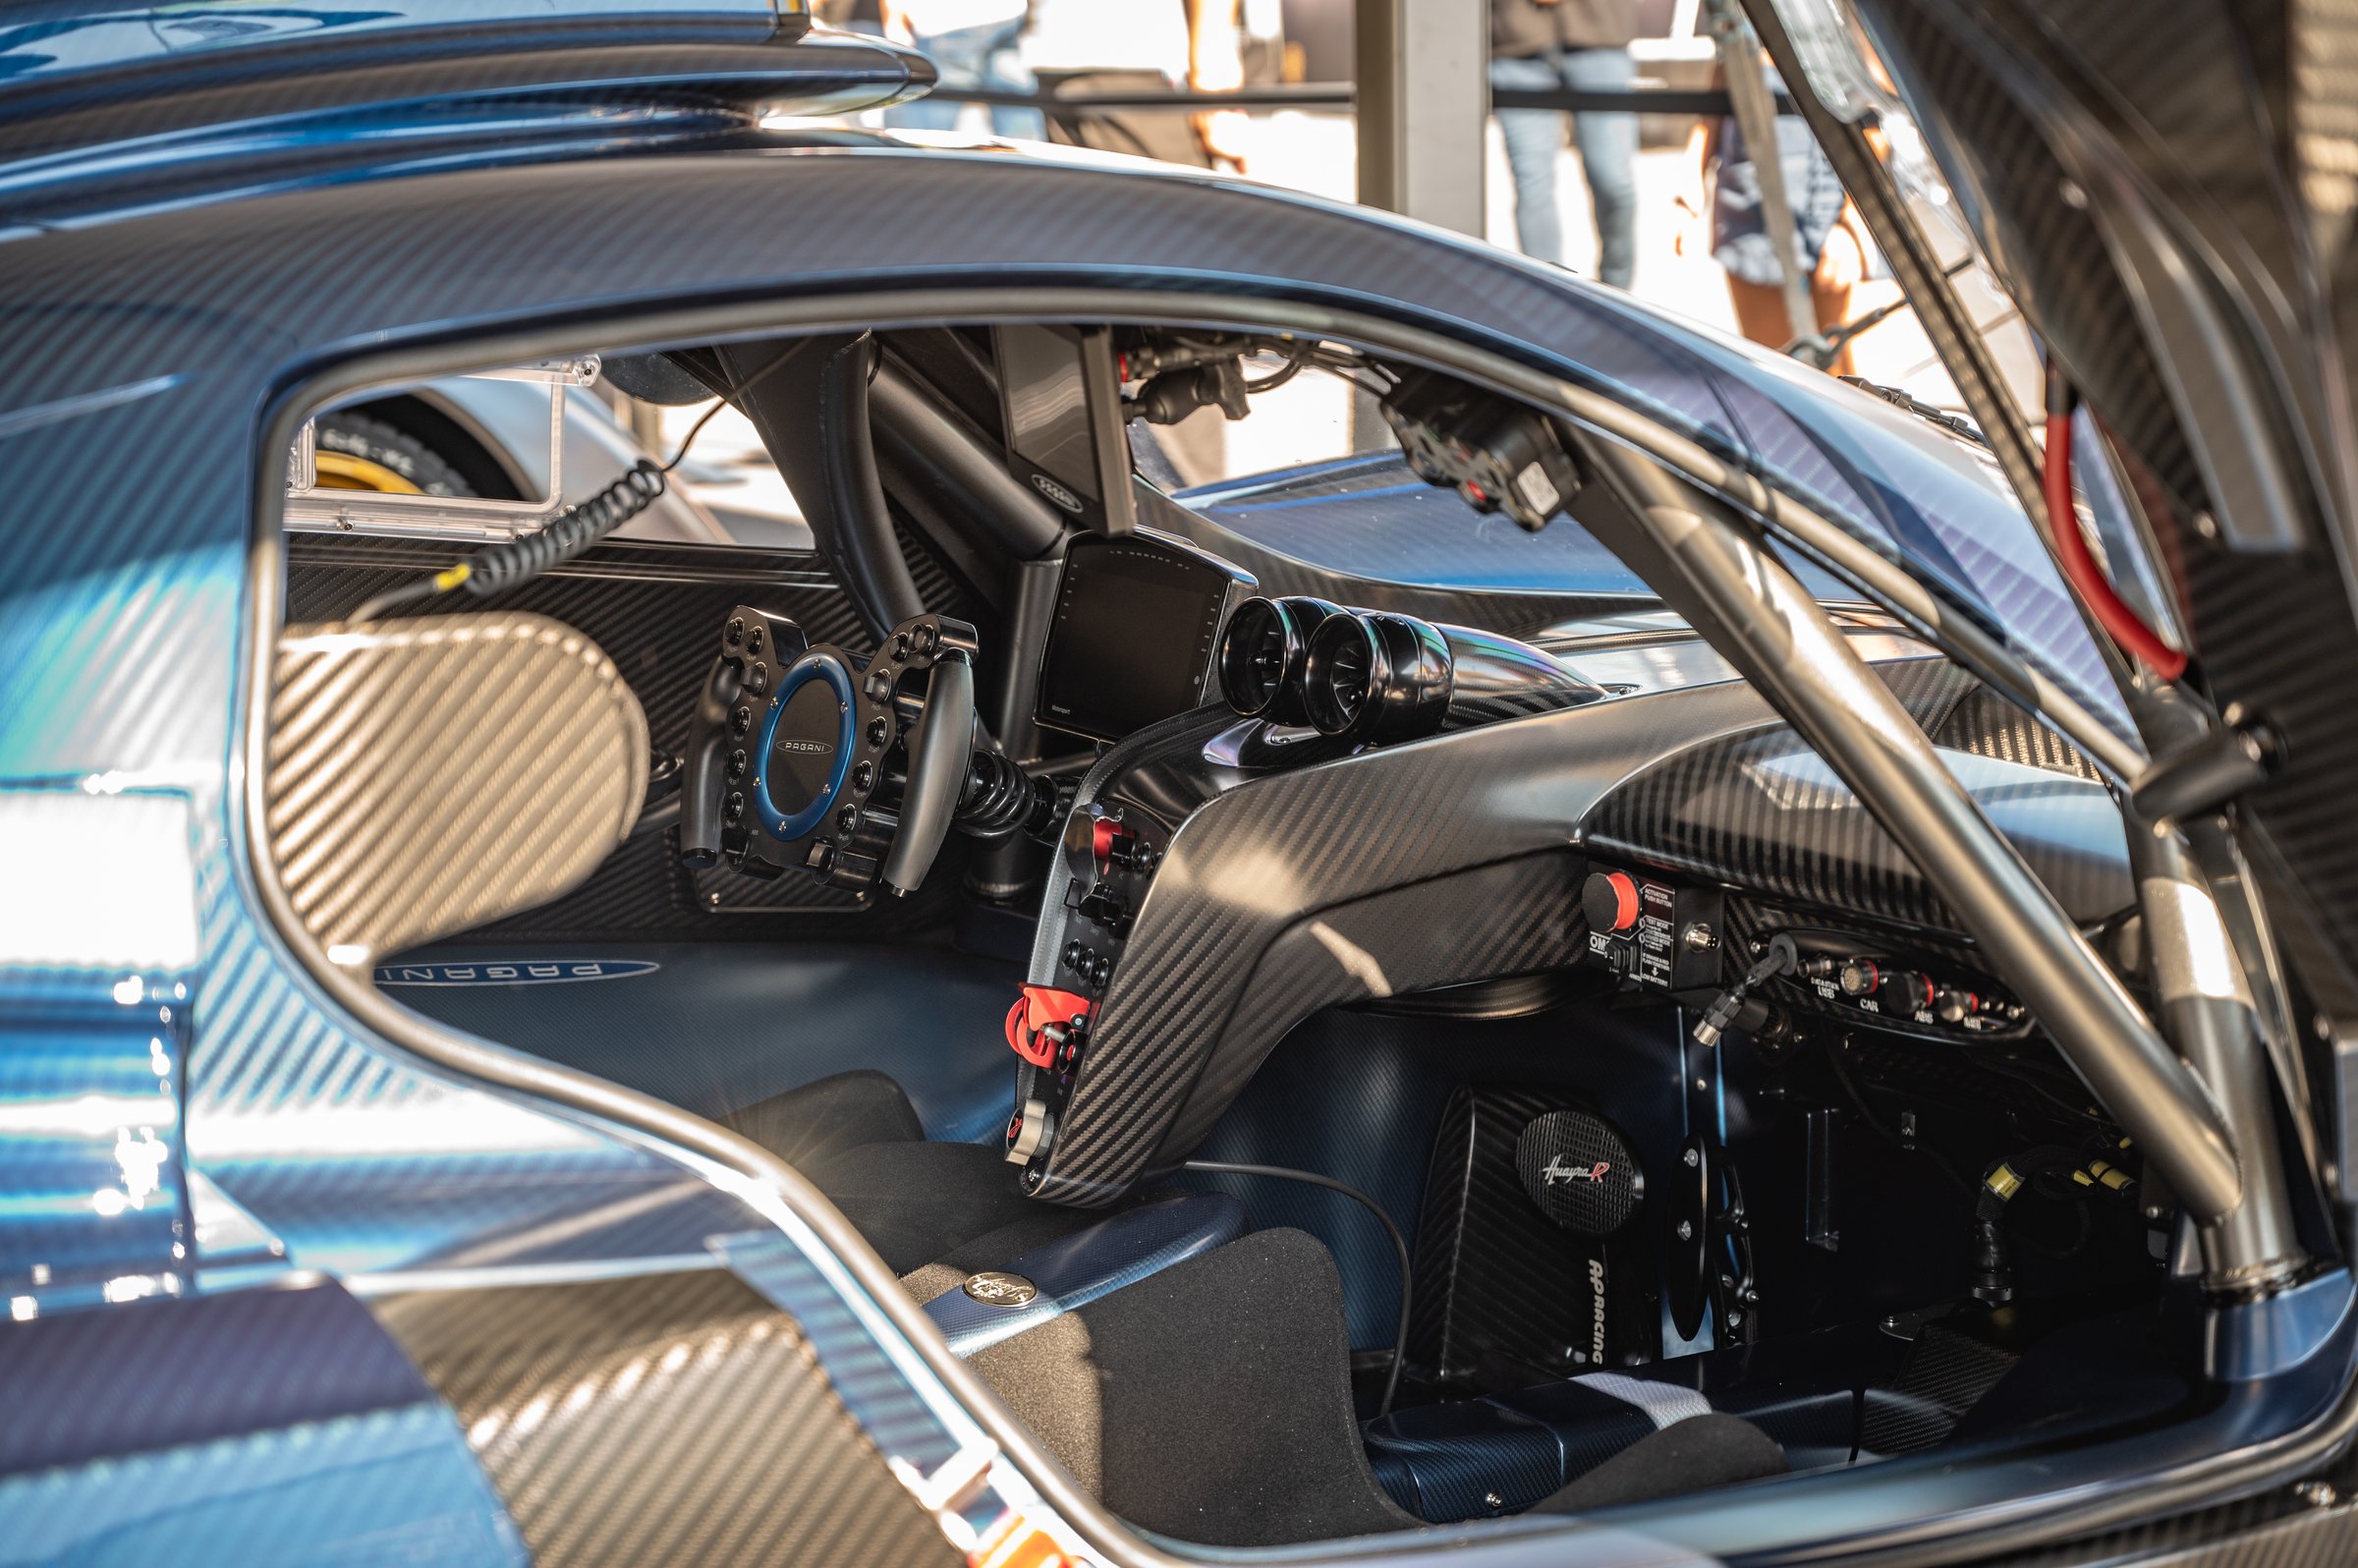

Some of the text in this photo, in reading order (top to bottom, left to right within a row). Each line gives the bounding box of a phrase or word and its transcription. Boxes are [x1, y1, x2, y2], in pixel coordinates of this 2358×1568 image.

[785, 742, 825, 753] PAGANI
[1645, 887, 1669, 901] ACTIVATION
[1656, 896, 1672, 909] BUTTON
[1646, 917, 1656, 926] TEST
[1656, 919, 1669, 930] MODE
[1590, 934, 1609, 952] OM
[384, 963, 603, 980] PAGANI
[1818, 985, 1835, 1000] USB
[1860, 997, 1880, 1013] CAR
[1542, 1153, 1610, 1186] Huayra R
